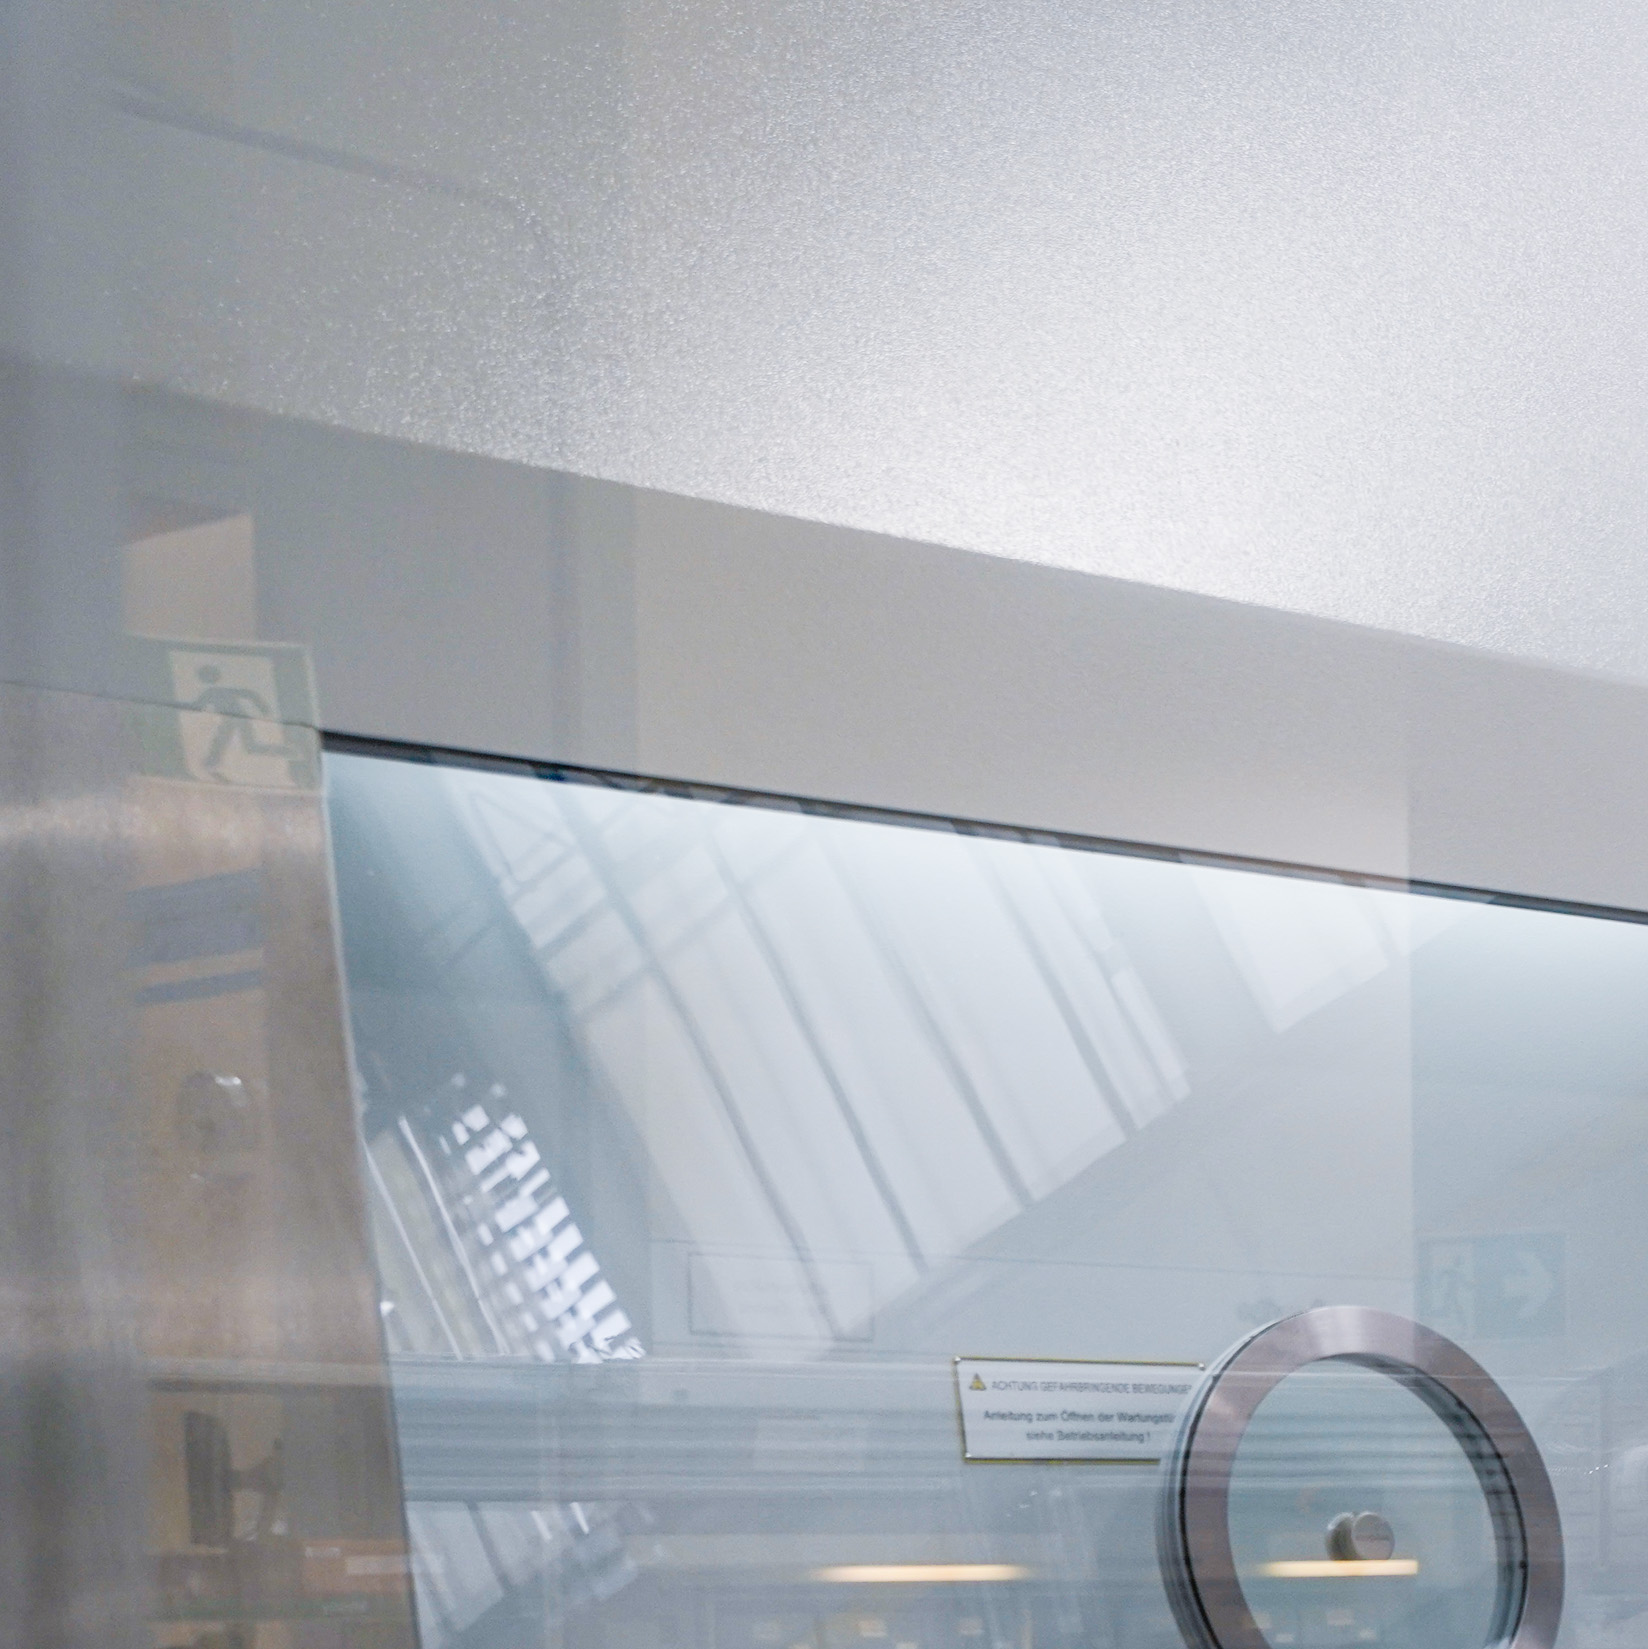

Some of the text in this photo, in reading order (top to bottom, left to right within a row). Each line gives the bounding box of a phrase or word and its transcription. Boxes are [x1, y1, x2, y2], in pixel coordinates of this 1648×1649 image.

[991, 1380, 1038, 1392] ACHTUNG
[984, 1410, 1033, 1423] Anleitung
[1036, 1413, 1057, 1421] zum
[1060, 1409, 1094, 1421] Öffnen
[1098, 1412, 1114, 1422] der
[1026, 1430, 1054, 1441] siehe
